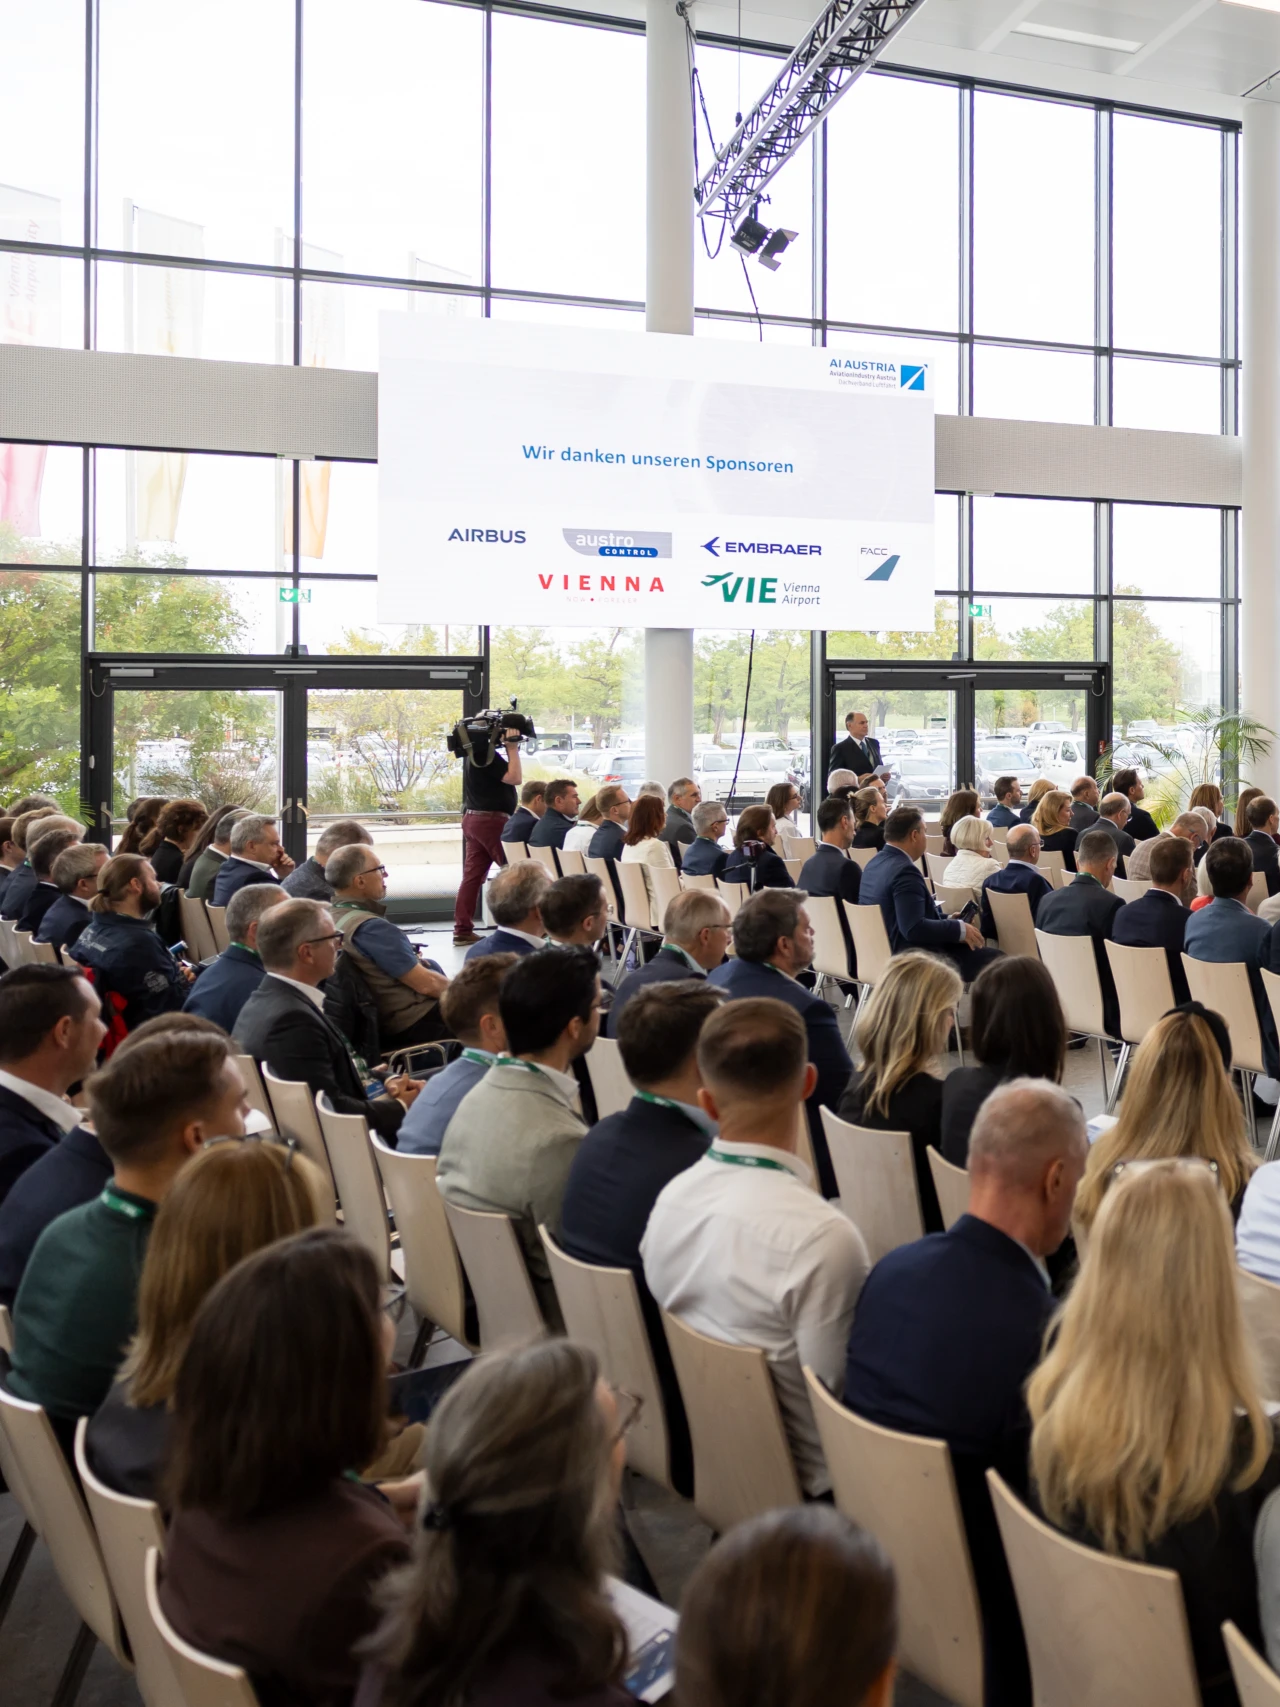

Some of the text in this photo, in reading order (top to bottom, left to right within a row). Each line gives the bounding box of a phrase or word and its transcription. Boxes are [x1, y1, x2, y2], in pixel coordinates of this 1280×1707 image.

[830, 359, 896, 372] AI AUSTRIA
[522, 445, 794, 474] Wir danken unseren Sponsoren
[448, 528, 526, 544] AIRBUS
[576, 532, 634, 548] austro
[605, 548, 652, 556] CONTROL
[725, 542, 822, 556] EMBRAER
[860, 548, 888, 556] FACC
[538, 574, 664, 592] VIENNA
[721, 576, 778, 604] VIE
[783, 582, 820, 593] Vienna
[782, 594, 821, 606] Airport
